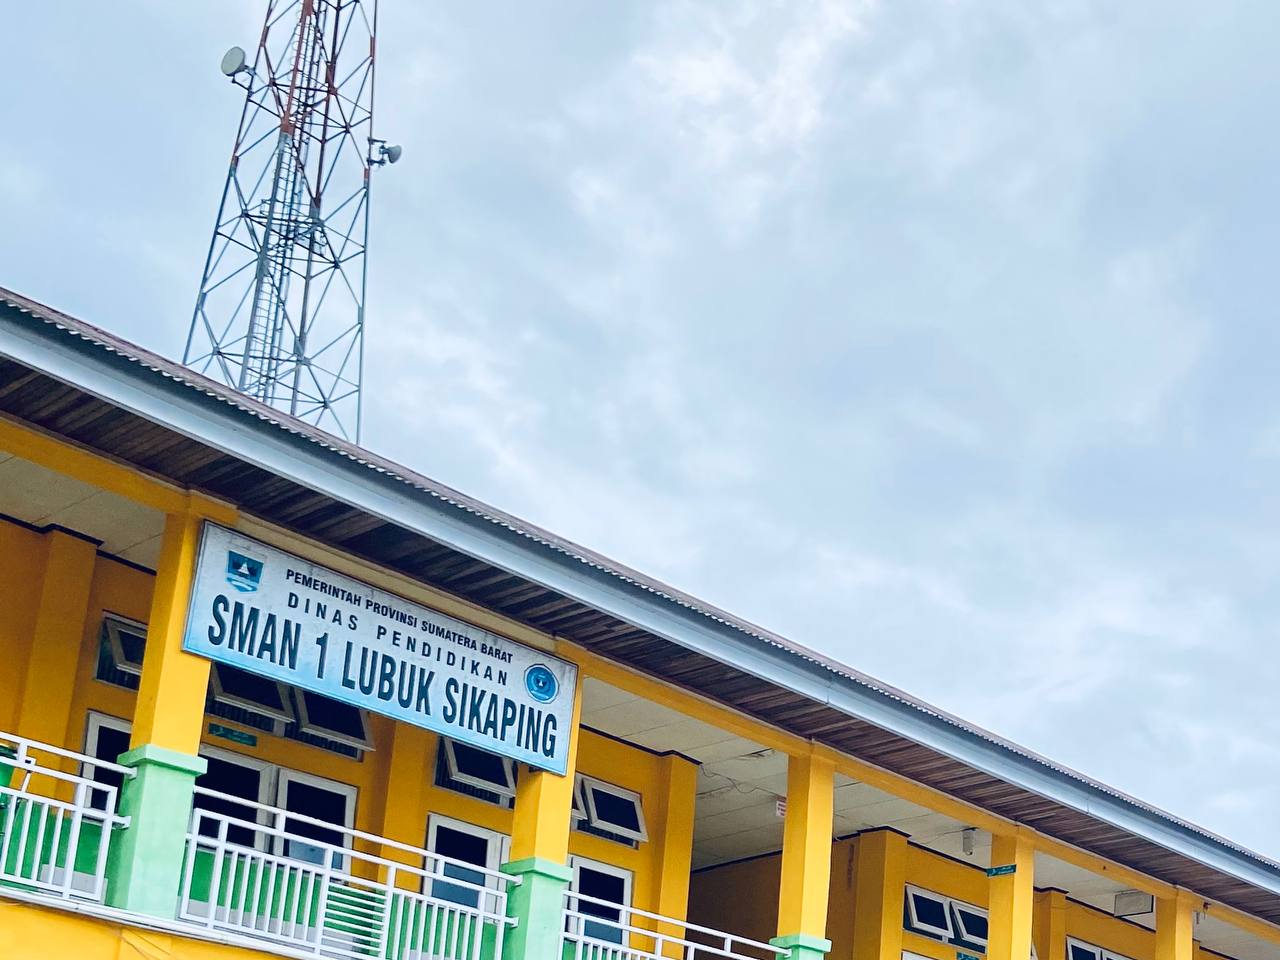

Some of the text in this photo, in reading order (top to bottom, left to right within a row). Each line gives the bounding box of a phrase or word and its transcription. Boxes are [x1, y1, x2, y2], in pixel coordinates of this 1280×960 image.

[286, 568, 514, 664] PEMERINTAH PROVINSI SUMATERA BARAT
[287, 592, 508, 686] DINAS PENDIDIKAN
[207, 594, 558, 759] SMAN 1 LUBUK SIKAPING
